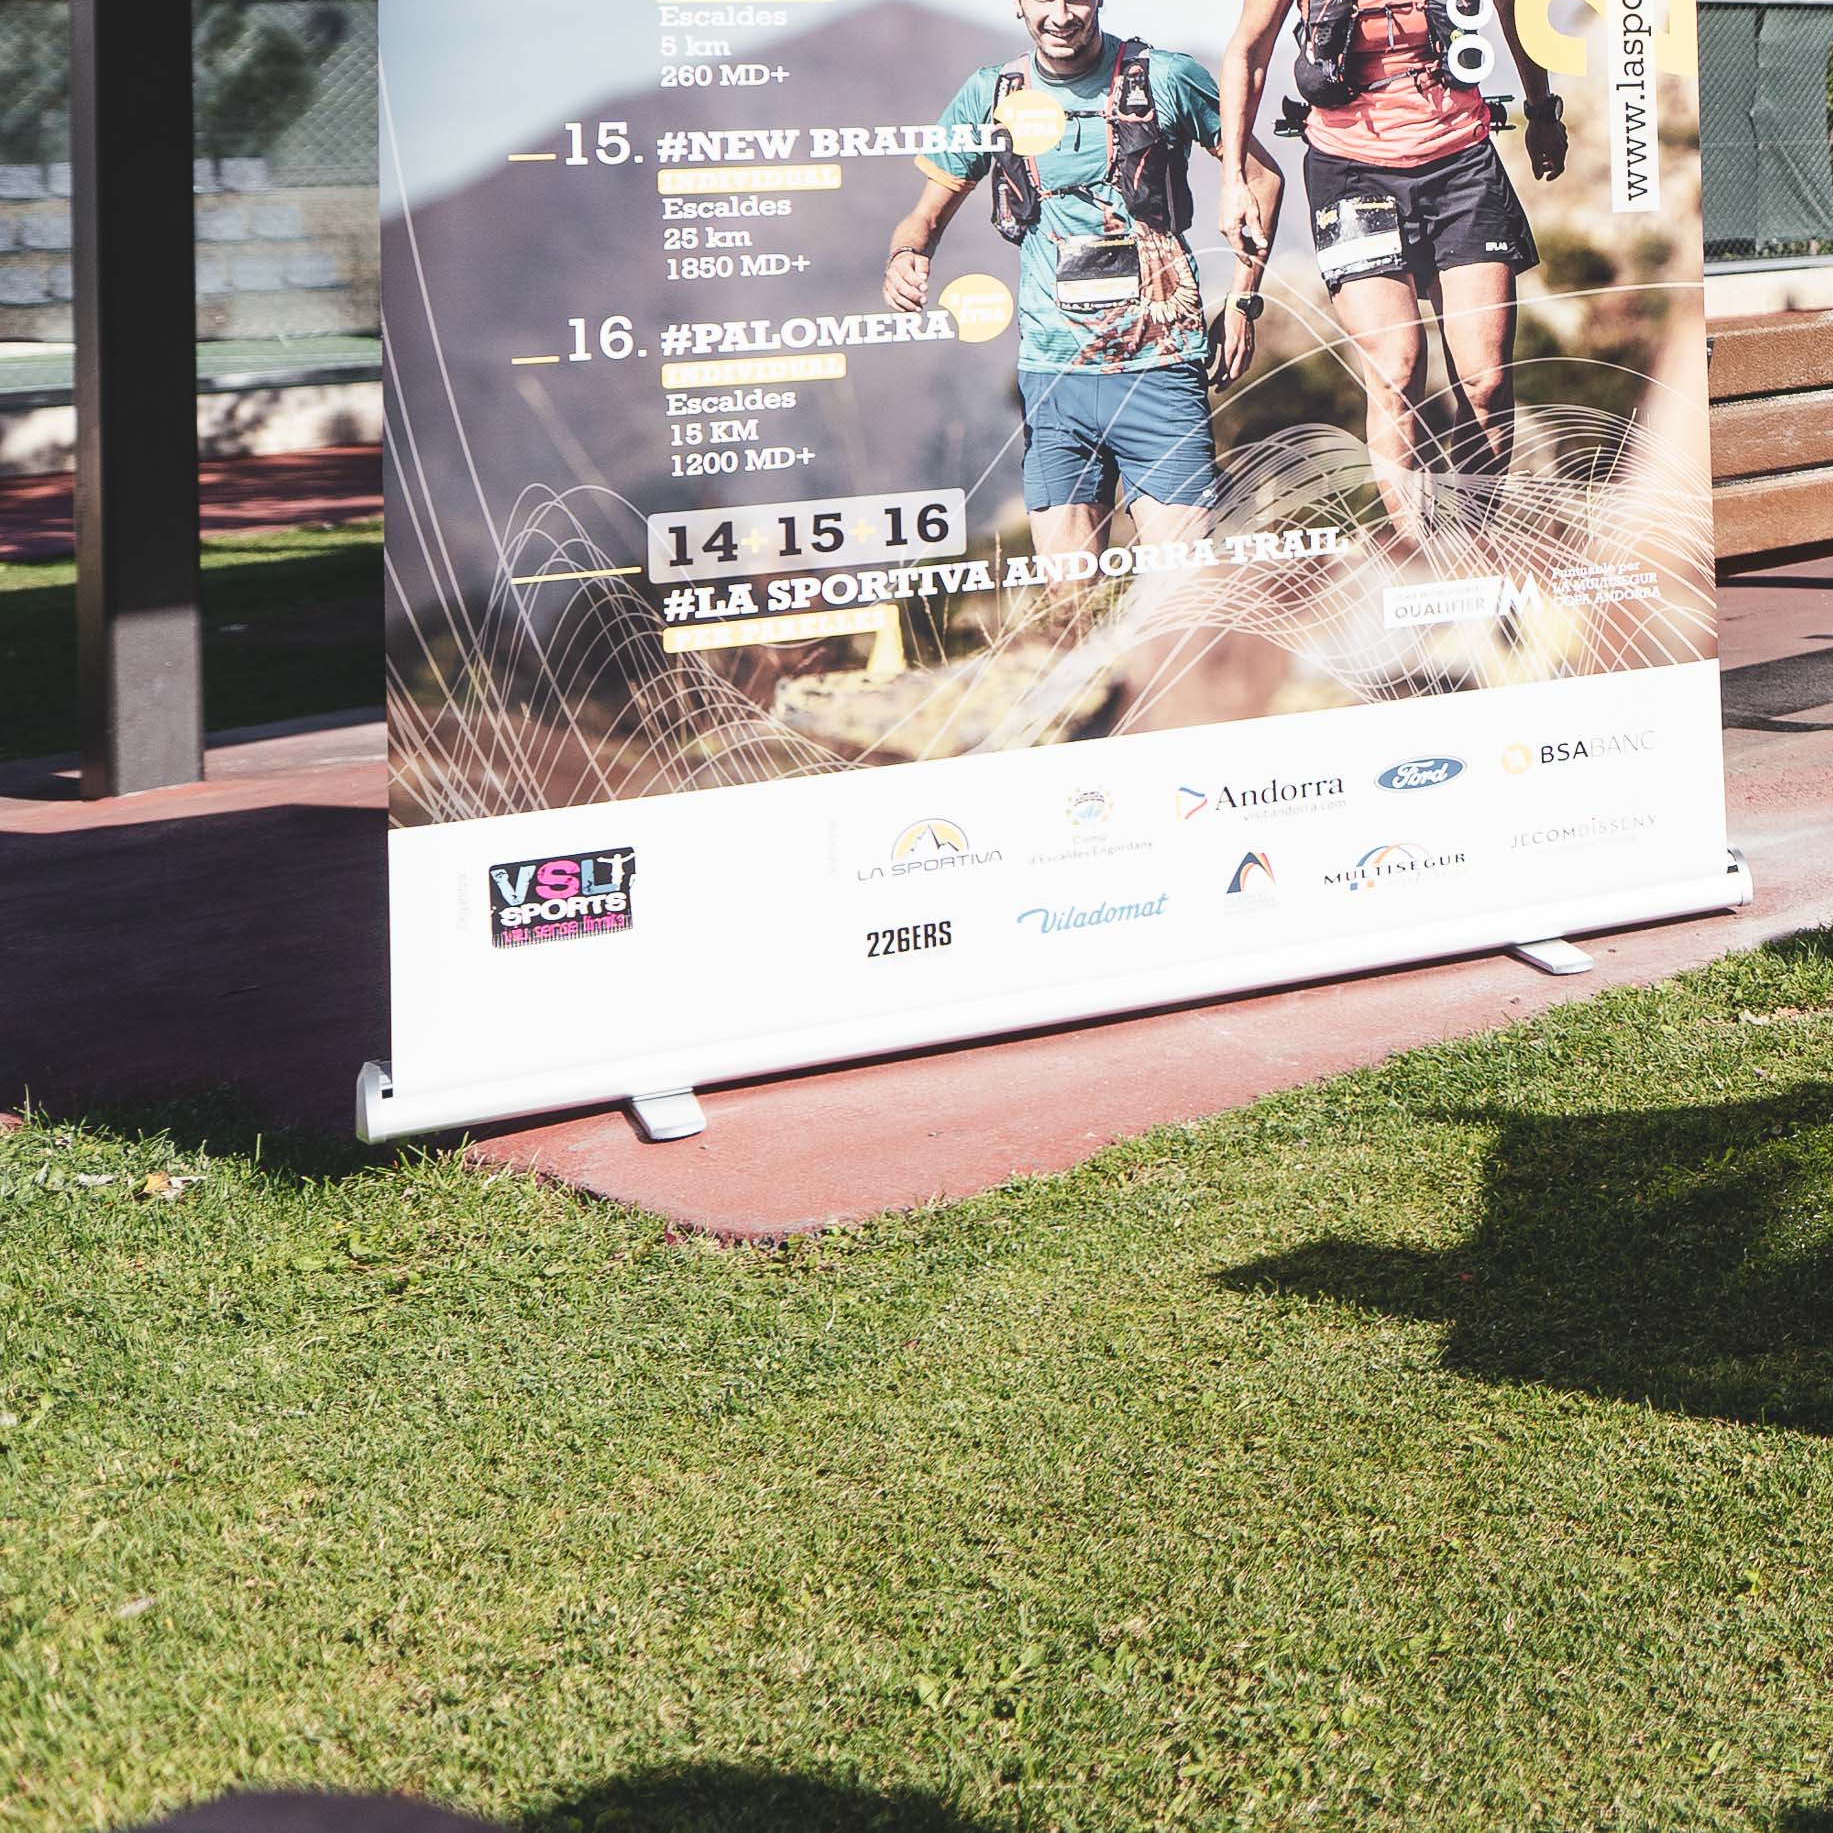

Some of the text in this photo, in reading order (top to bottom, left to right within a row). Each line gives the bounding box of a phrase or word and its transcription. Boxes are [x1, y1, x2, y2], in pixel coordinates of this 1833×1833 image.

[659, 5, 787, 27] Escaldes
[660, 35, 731, 57] 5 km
[660, 64, 790, 87] 260 MD+
[564, 123, 645, 165] 15.
[656, 129, 800, 164] #NEW
[808, 123, 1007, 159] BRAIBAL
[662, 197, 792, 221] Escaldes
[663, 226, 753, 251] 25 km
[667, 252, 811, 281] 1850 MD+
[567, 310, 955, 362] 16. #PALOMERA
[666, 389, 797, 417] Escaldes
[670, 420, 760, 448] 15 KM
[670, 447, 816, 479] 1200 MD+
[667, 521, 738, 567] 14
[777, 512, 844, 558] 15
[883, 502, 950, 547] 16
[663, 525, 1351, 623] #LA SPORTIVA ANDORRA TRAIL
[1214, 773, 1345, 812] Andorra
[891, 850, 1003, 878] SPORTIVA
[1323, 852, 1466, 885] MULTISEGUR
[499, 892, 627, 927] SPORTS
[1016, 892, 1170, 936] Viladomat
[866, 921, 953, 958] 226ERS
